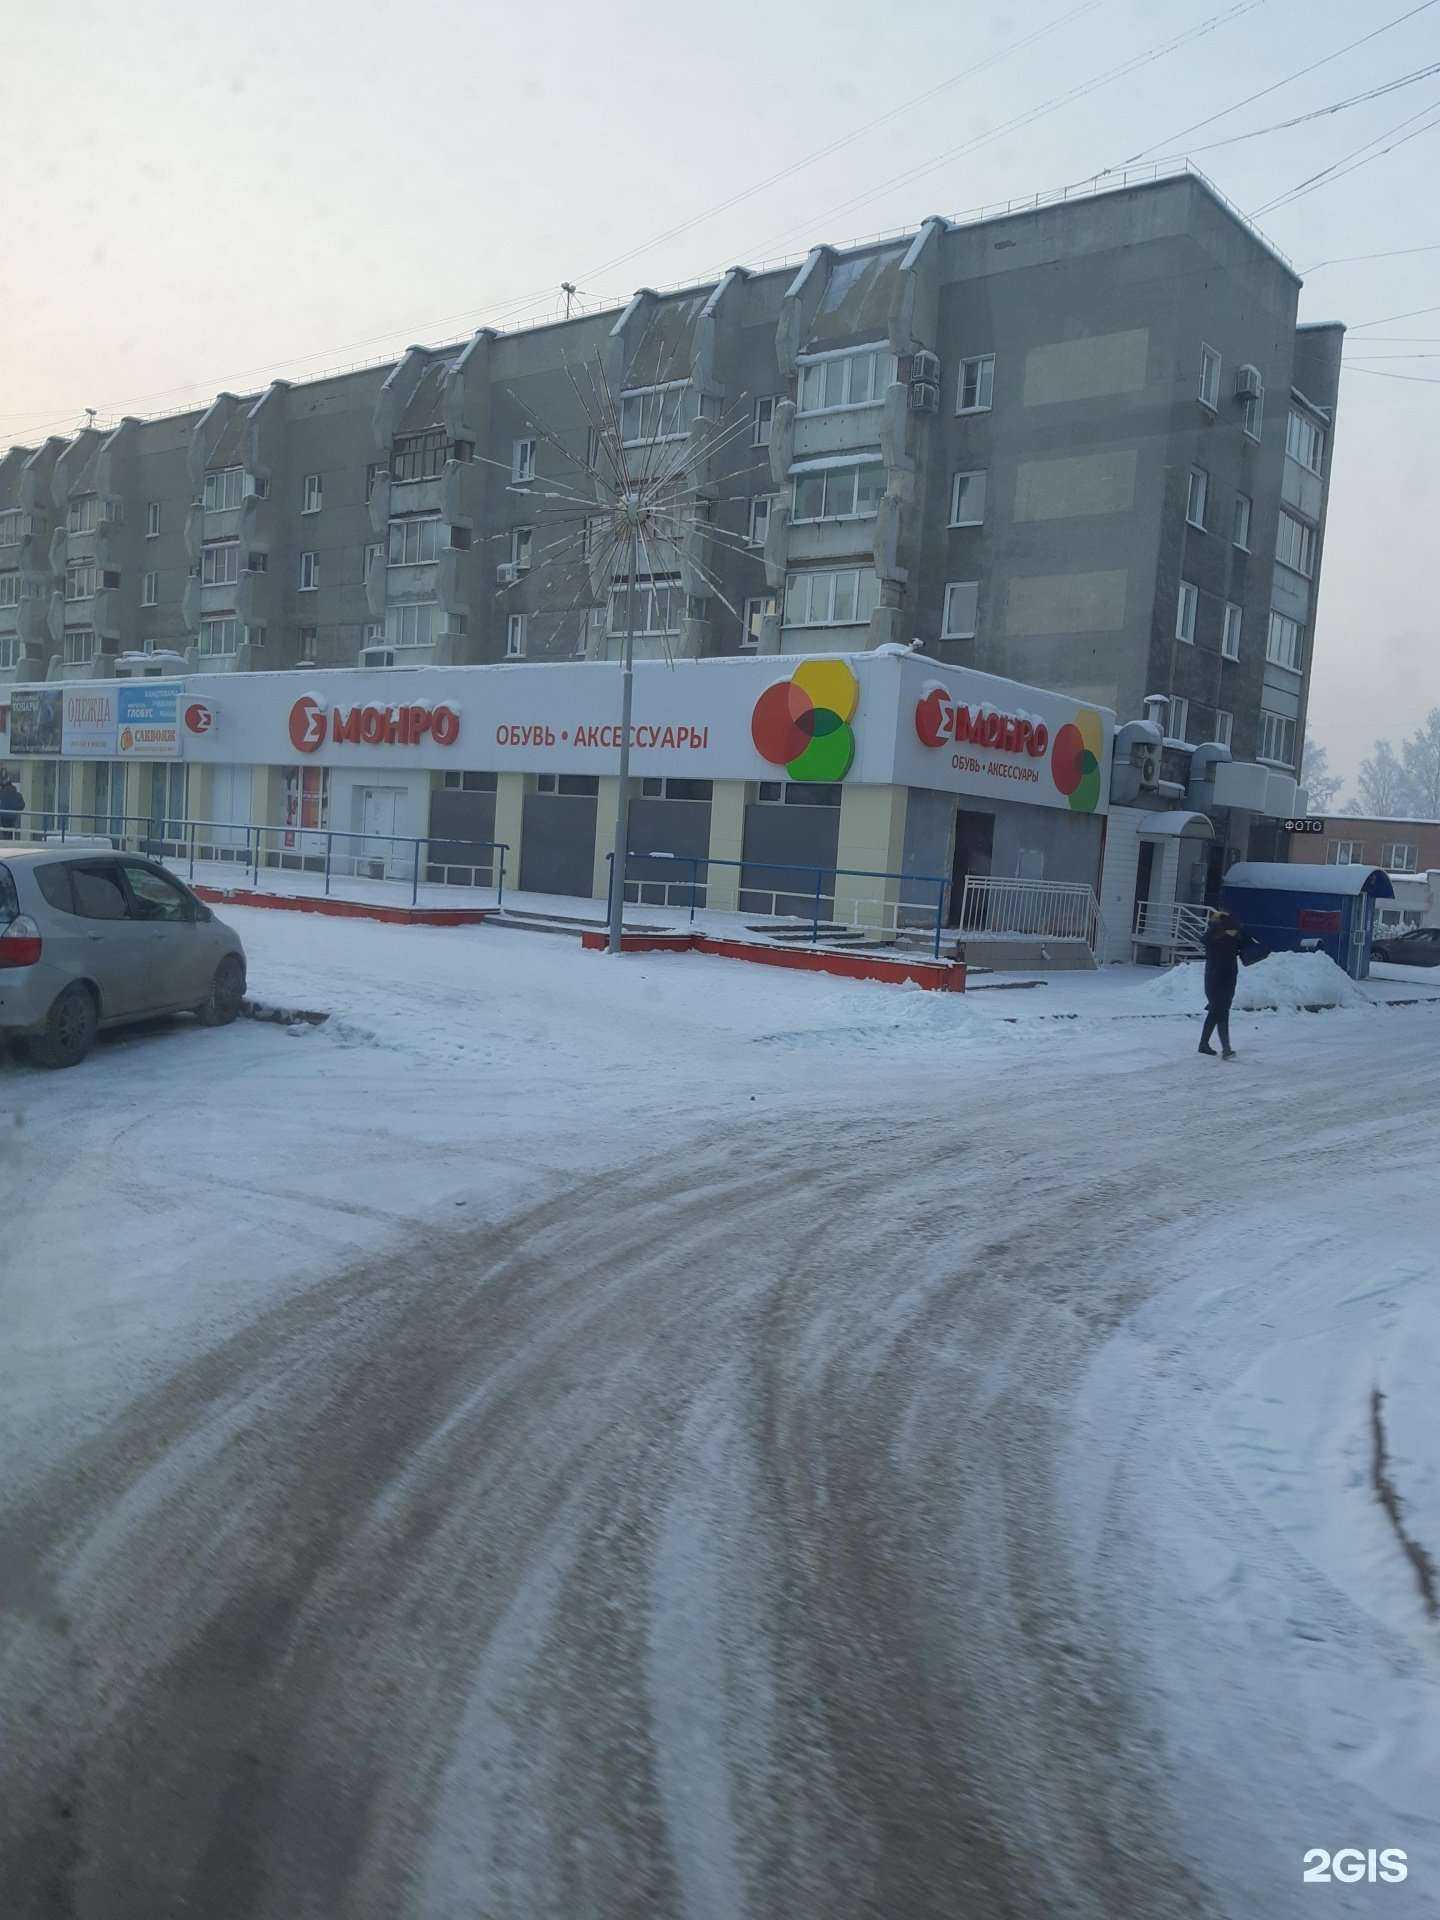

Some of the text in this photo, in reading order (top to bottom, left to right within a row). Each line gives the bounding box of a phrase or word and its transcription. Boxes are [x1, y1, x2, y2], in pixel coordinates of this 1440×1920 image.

[68, 697, 111, 728] ОДЕЖДА
[332, 704, 460, 745] МОНРО
[496, 724, 556, 746] ОБУВЬ
[955, 704, 1048, 757] МОНРО
[952, 754, 1039, 783] ОБУВЬ АКСЕССУАРЫ
[1284, 820, 1322, 832] ФОТО
